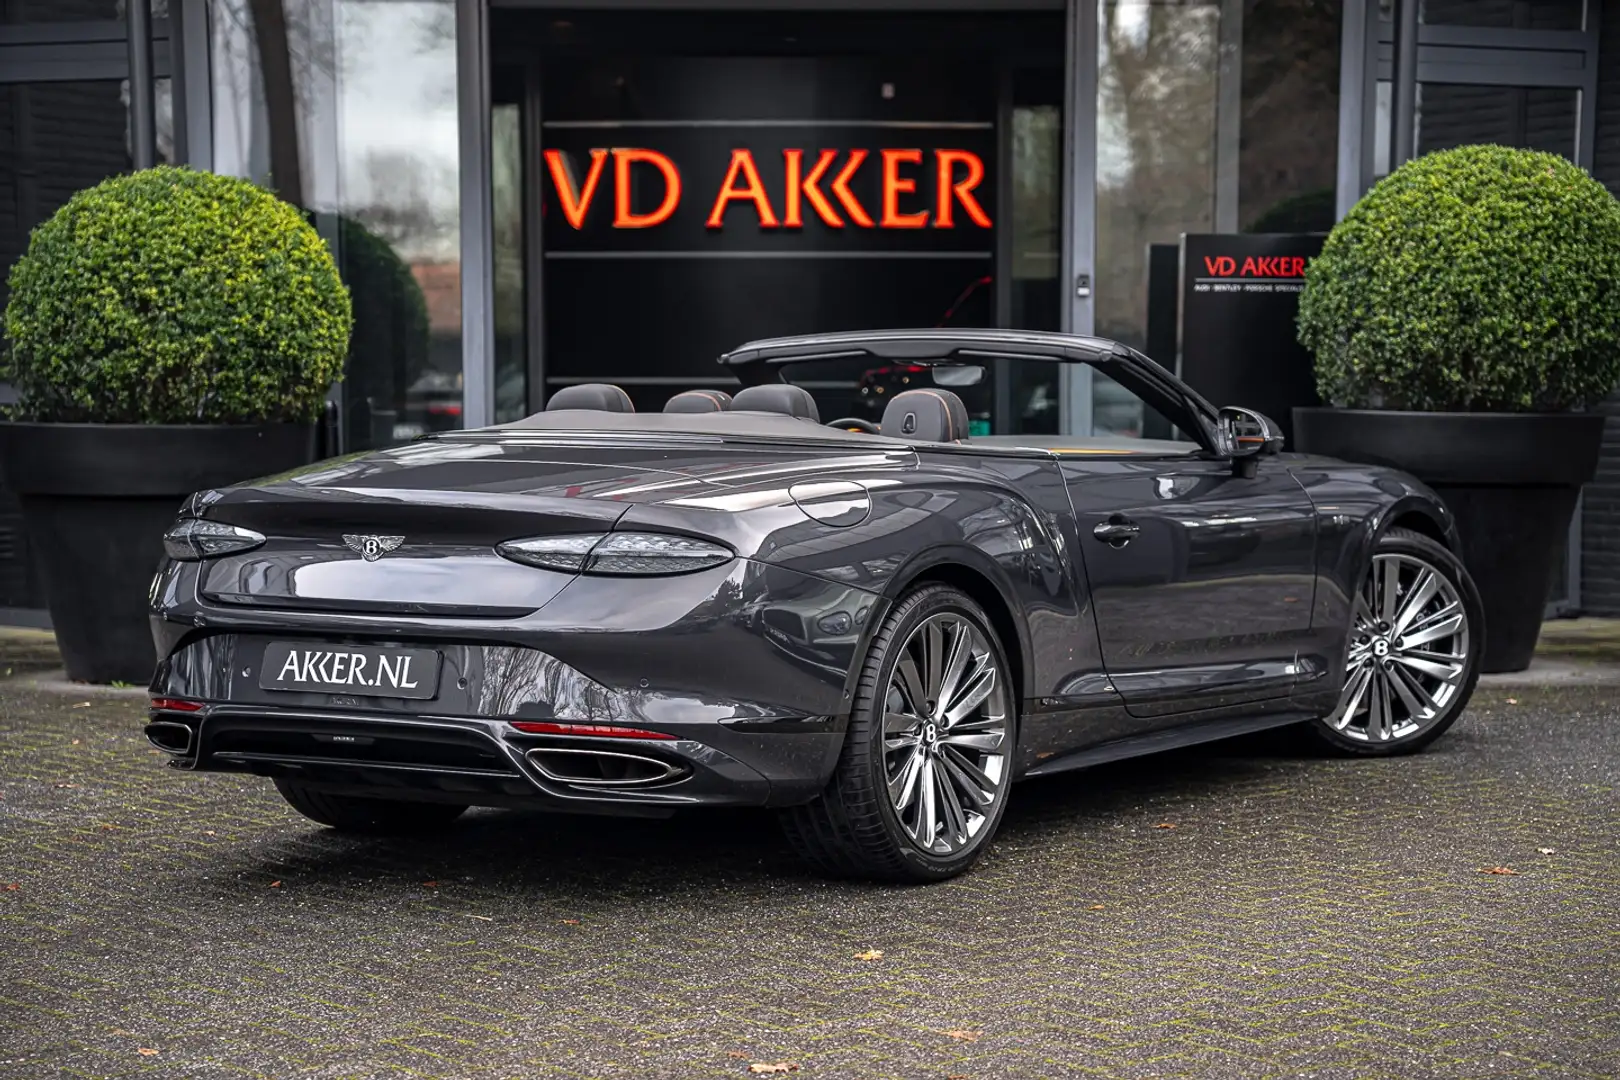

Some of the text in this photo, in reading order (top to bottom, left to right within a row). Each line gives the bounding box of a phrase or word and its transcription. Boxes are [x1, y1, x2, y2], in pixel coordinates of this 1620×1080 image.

[543, 147, 993, 229] VD AKKER
[1204, 256, 1305, 277] VD AKKER
[367, 539, 378, 554] B
[1375, 640, 1388, 656] B
[276, 650, 418, 689] AKKER.NL
[926, 723, 937, 743] B
